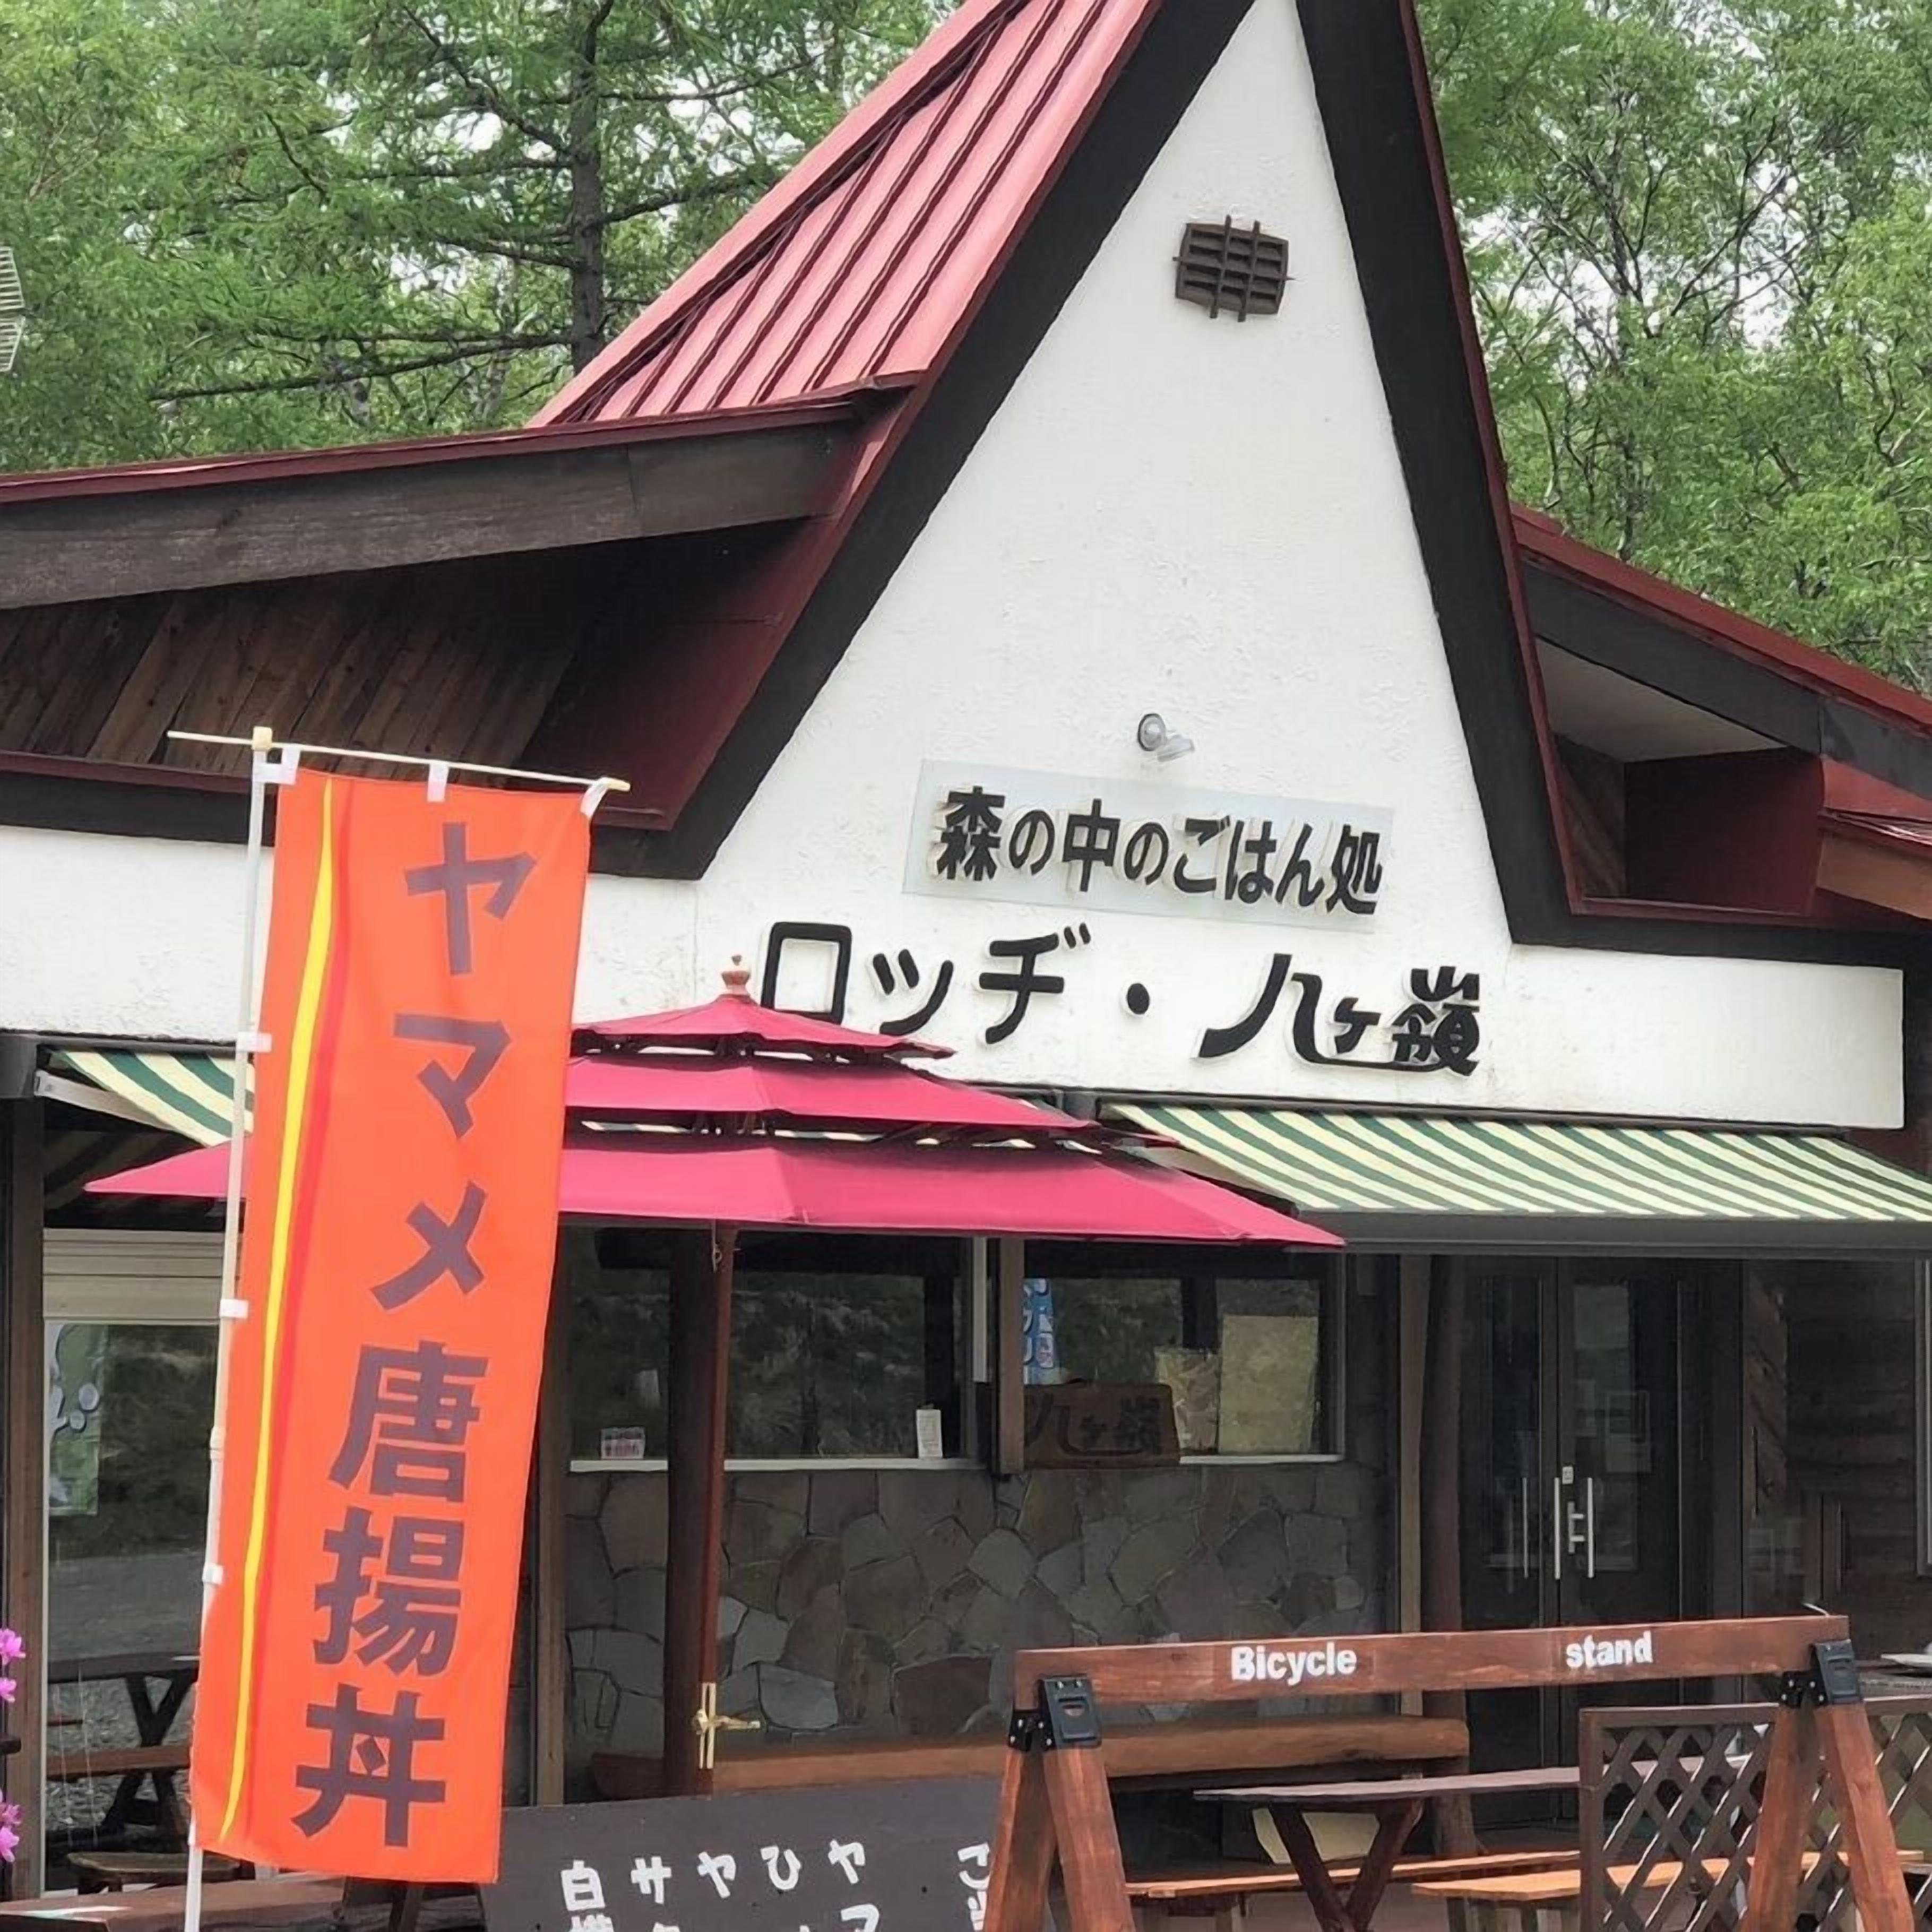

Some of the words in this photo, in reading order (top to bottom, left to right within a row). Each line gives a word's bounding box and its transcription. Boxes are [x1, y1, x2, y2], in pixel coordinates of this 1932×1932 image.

[936, 786, 1382, 915] 森の中のごはん処
[291, 821, 536, 1848] ヤマメ唐揚丼
[1231, 1642, 1357, 1686] Bicycle
[1566, 1631, 1653, 1669] stand
